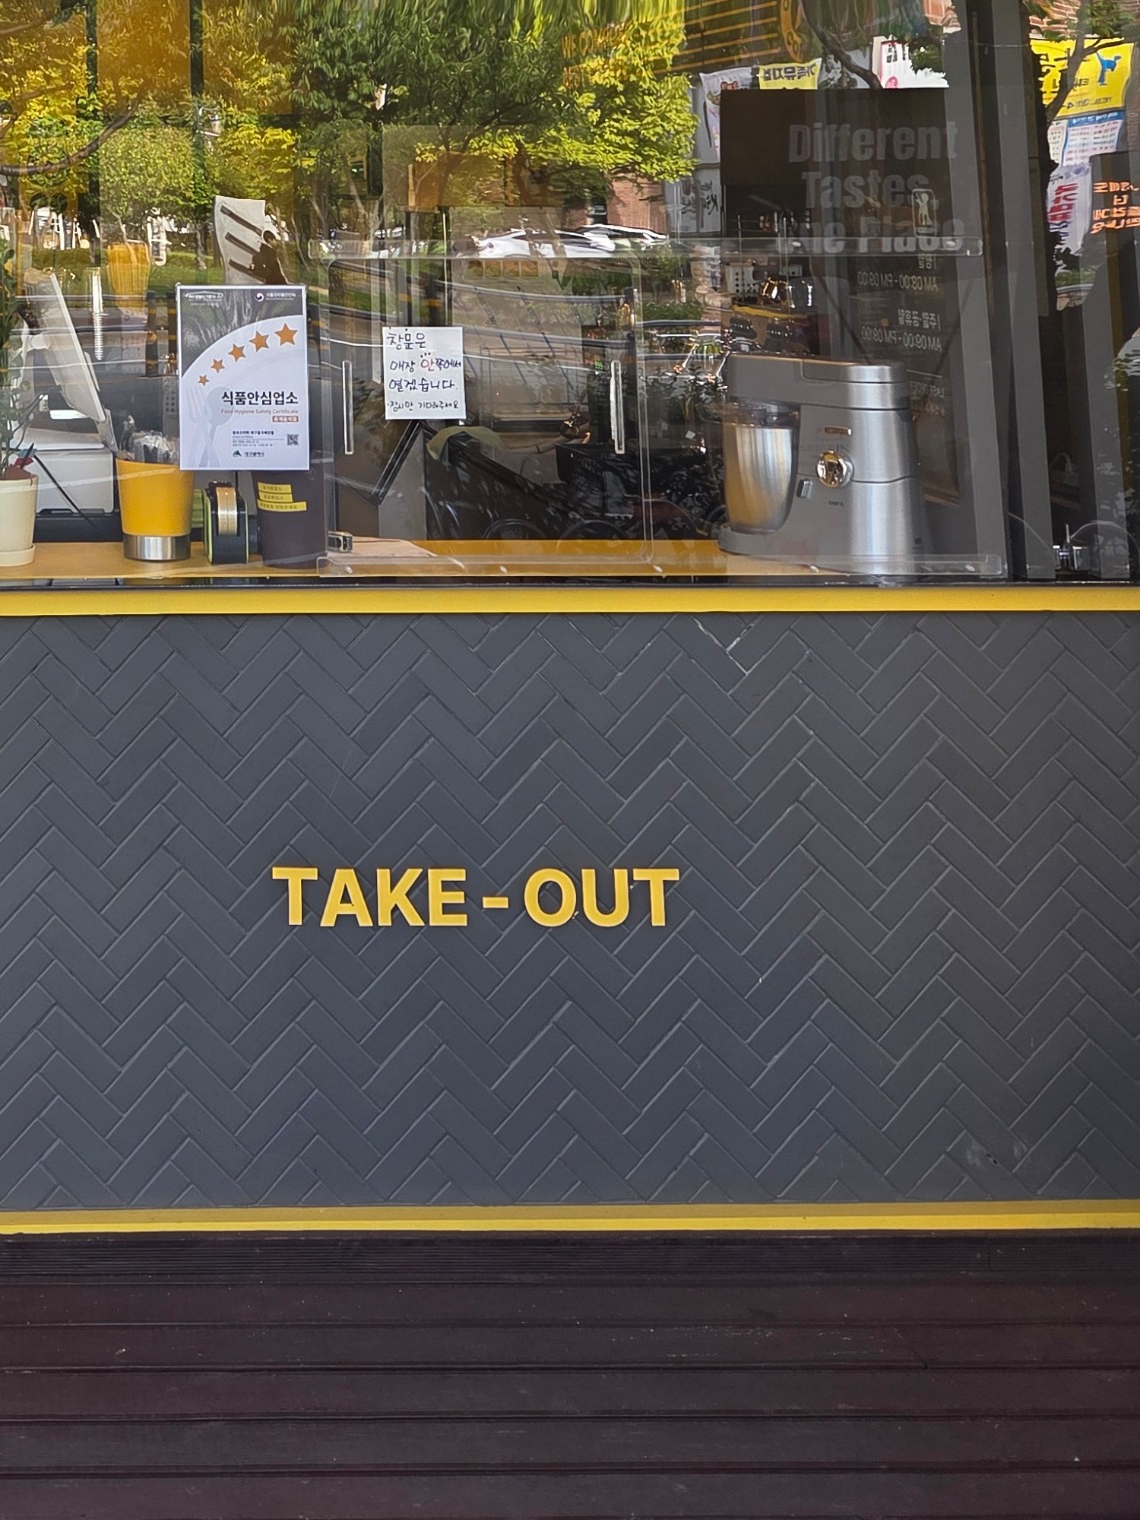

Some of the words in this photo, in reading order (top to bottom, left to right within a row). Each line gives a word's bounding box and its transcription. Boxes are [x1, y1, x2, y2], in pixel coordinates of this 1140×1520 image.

[788, 120, 960, 163] Different
[389, 360, 416, 373] 매장
[221, 390, 299, 406] 식품안심업소
